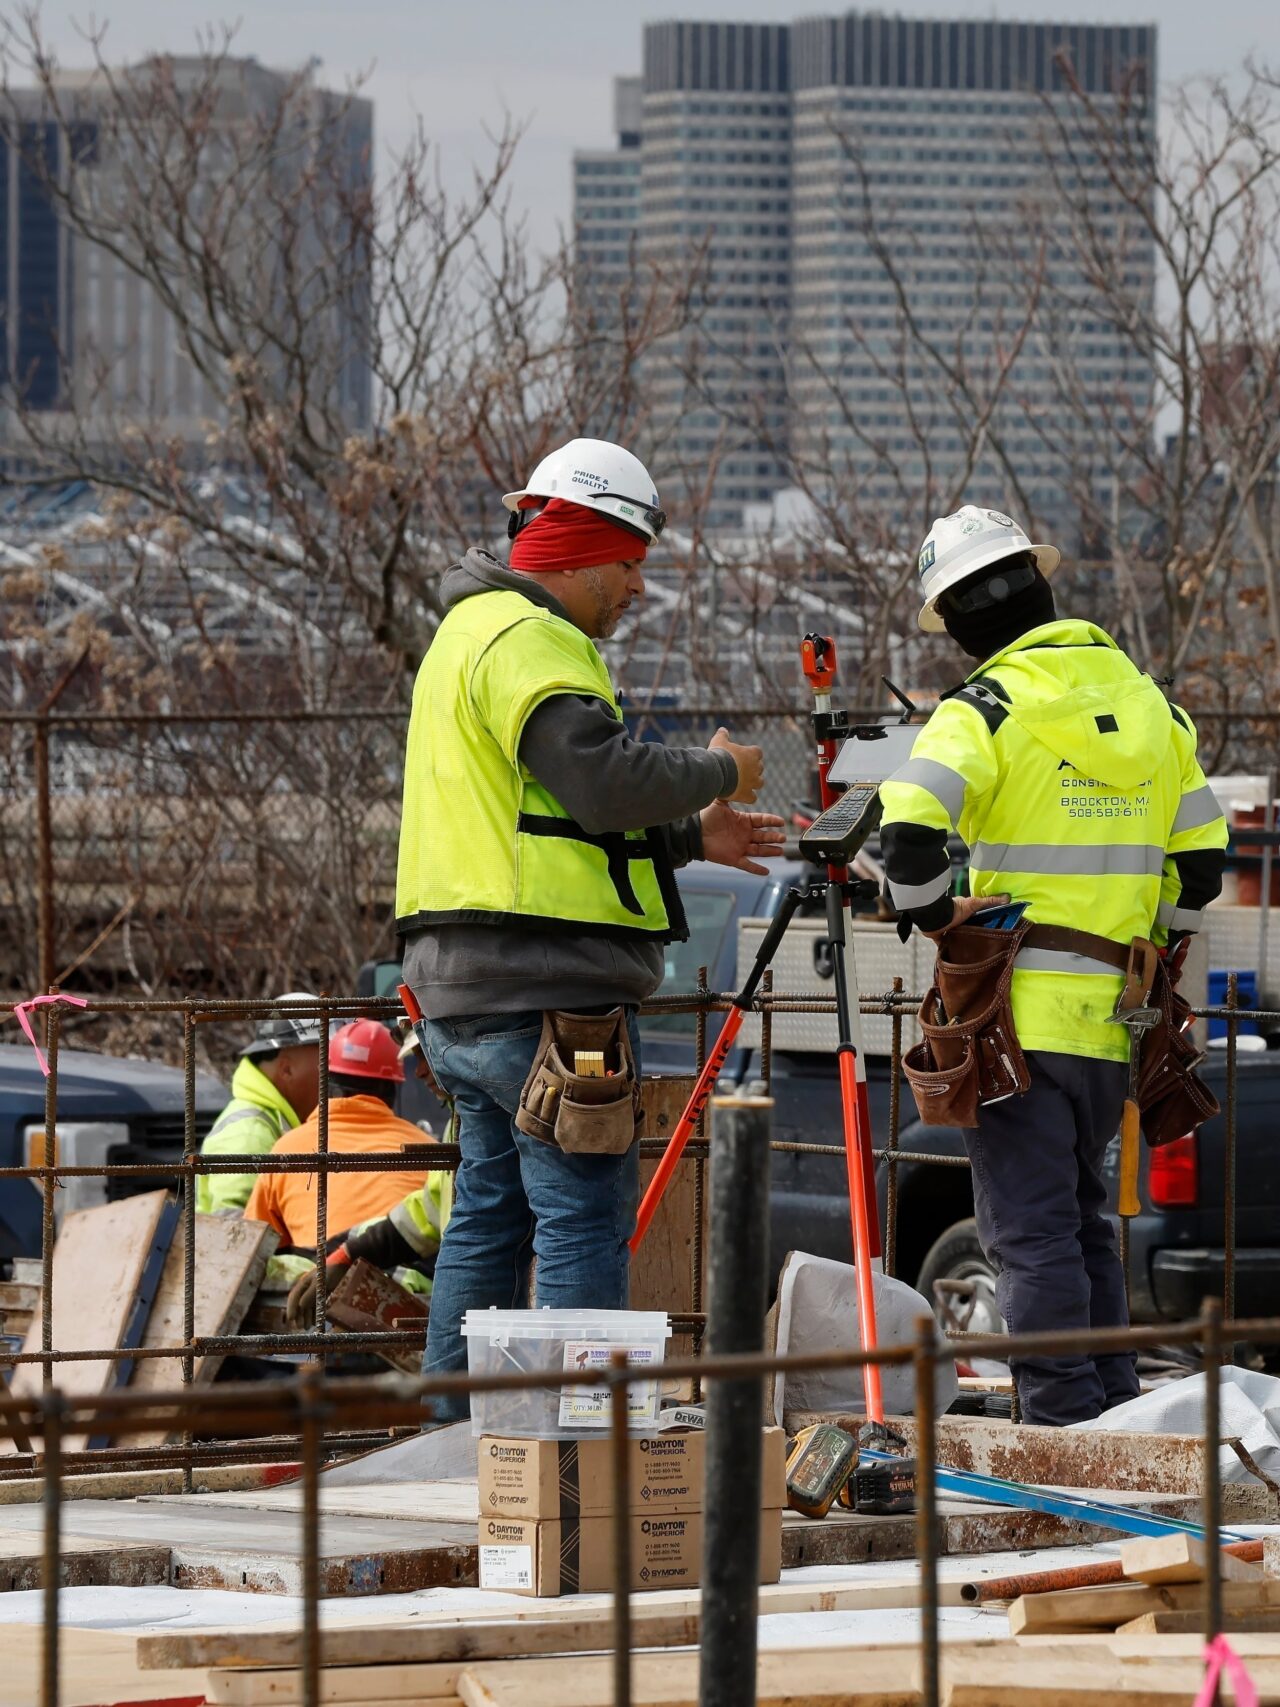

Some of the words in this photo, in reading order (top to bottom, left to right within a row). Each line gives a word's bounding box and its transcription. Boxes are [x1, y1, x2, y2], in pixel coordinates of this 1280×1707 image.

[574, 470, 601, 482] PRIDE
[571, 477, 608, 491] QUALITY
[651, 1440, 685, 1449] DAYTON
[499, 1447, 526, 1456] DAYTON
[651, 1448, 685, 1456] SUPERIOR
[499, 1456, 526, 1464] SUPERIOR
[652, 1487, 687, 1496] SYMONS
[499, 1495, 527, 1504] SYMONS
[496, 1525, 523, 1535] DAYTON
[652, 1521, 685, 1530] DAYTON
[496, 1533, 523, 1541] SUPERIOR
[652, 1529, 685, 1537] SUPERIOR
[652, 1568, 686, 1577] SYMONS
